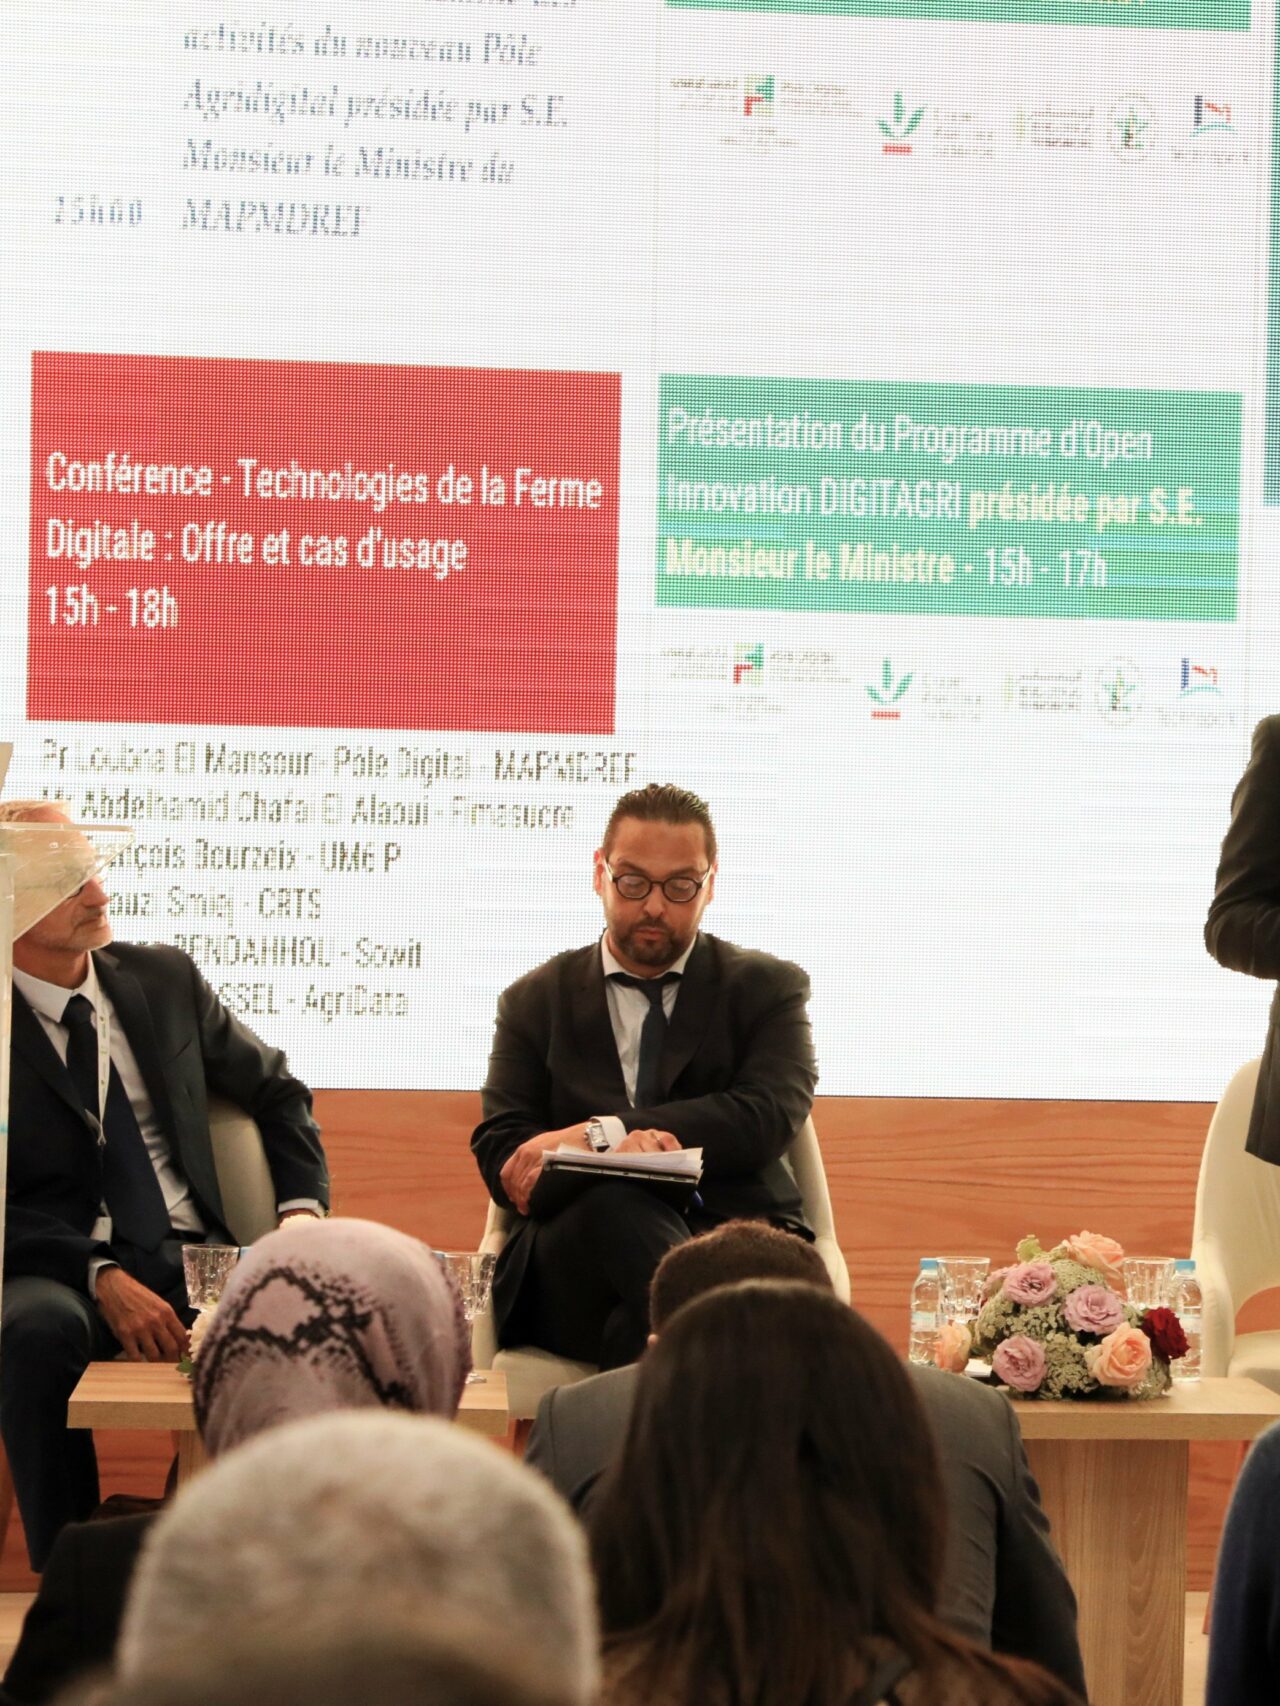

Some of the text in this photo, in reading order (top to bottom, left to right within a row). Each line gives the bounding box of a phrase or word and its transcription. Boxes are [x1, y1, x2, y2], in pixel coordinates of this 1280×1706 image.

[184, 21, 542, 66] activités du nouveau Pôle
[183, 78, 568, 132] Agridigital présidée par S.E.
[183, 138, 515, 184] Monsieur le Ministre du
[667, 408, 1152, 468] Présentation du Programme d'Open
[45, 451, 213, 496] Conférence
[237, 458, 428, 512] Technologies
[437, 465, 472, 506] de
[480, 466, 505, 506] la
[514, 469, 603, 509] Ferme
[666, 476, 1204, 533] Innovation DIGITAGRI présidée par S.E.
[45, 519, 155, 568] Digitale
[181, 522, 253, 564] Offre
[261, 530, 290, 565] et
[299, 534, 347, 567] cas
[357, 528, 467, 579] d'usage
[665, 538, 797, 580] Monsieur
[806, 540, 831, 581] le
[840, 543, 955, 584] Ministre
[984, 547, 1034, 587] 15h
[1060, 550, 1108, 588] 17h
[46, 587, 98, 626] 15h
[126, 587, 178, 628] 18h
[205, 743, 313, 776] Mansour
[334, 745, 388, 778] Pôle
[81, 788, 229, 822] Abdelhamid
[351, 794, 429, 826] Alaoui
[195, 838, 300, 870] Bourzeix
[259, 887, 321, 919] CRTS
